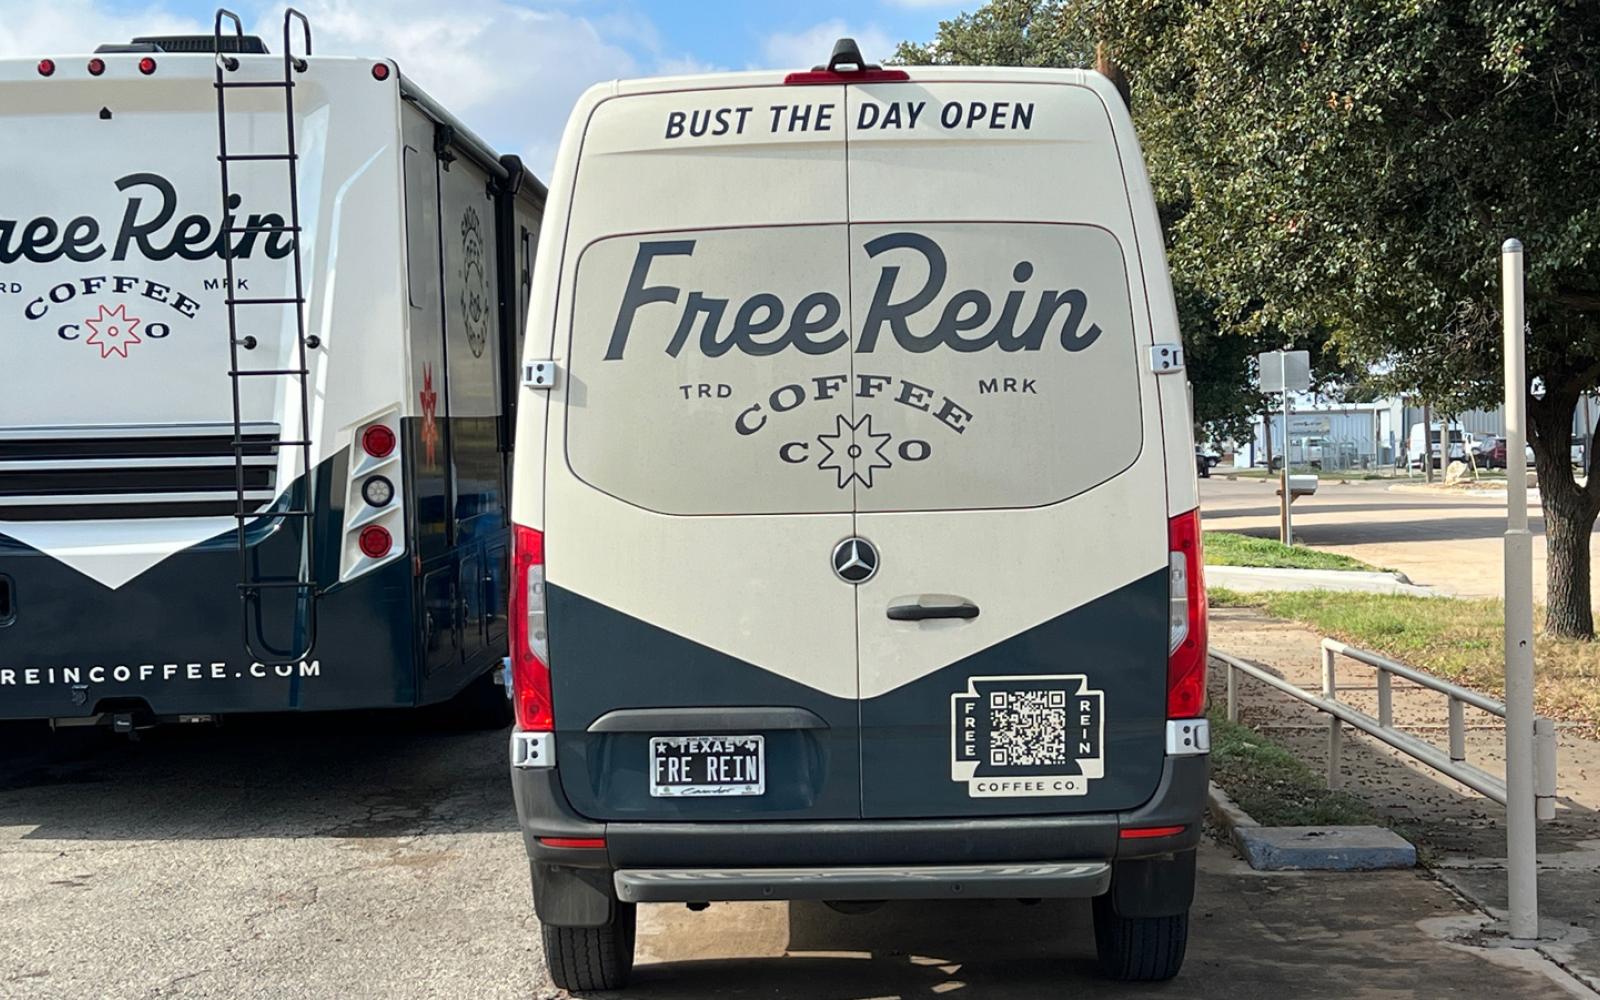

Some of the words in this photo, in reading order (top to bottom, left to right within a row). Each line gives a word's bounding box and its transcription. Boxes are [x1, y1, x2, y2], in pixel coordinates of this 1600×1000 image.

[665, 107, 753, 139] BUST
[770, 104, 834, 133] THE
[857, 101, 926, 130] DAY
[940, 102, 1034, 130] OPEN
[111, 173, 296, 261] Rein
[24, 275, 201, 320] COFFEE
[603, 239, 850, 361] Free
[854, 232, 1103, 353] Rein
[57, 324, 80, 340] C
[145, 323, 170, 339] O
[679, 383, 733, 400] TRD
[978, 377, 1038, 395] MRK
[735, 374, 974, 436] COFFEE
[779, 442, 809, 464] C
[898, 439, 932, 461] O
[965, 702, 976, 757] FREE
[1079, 700, 1091, 755] REIN
[679, 740, 735, 754] TEXAS
[656, 756, 692, 783] FRE
[707, 755, 757, 782] REIN
[977, 781, 1045, 793] COFFEE
[1053, 780, 1080, 791] CO.
